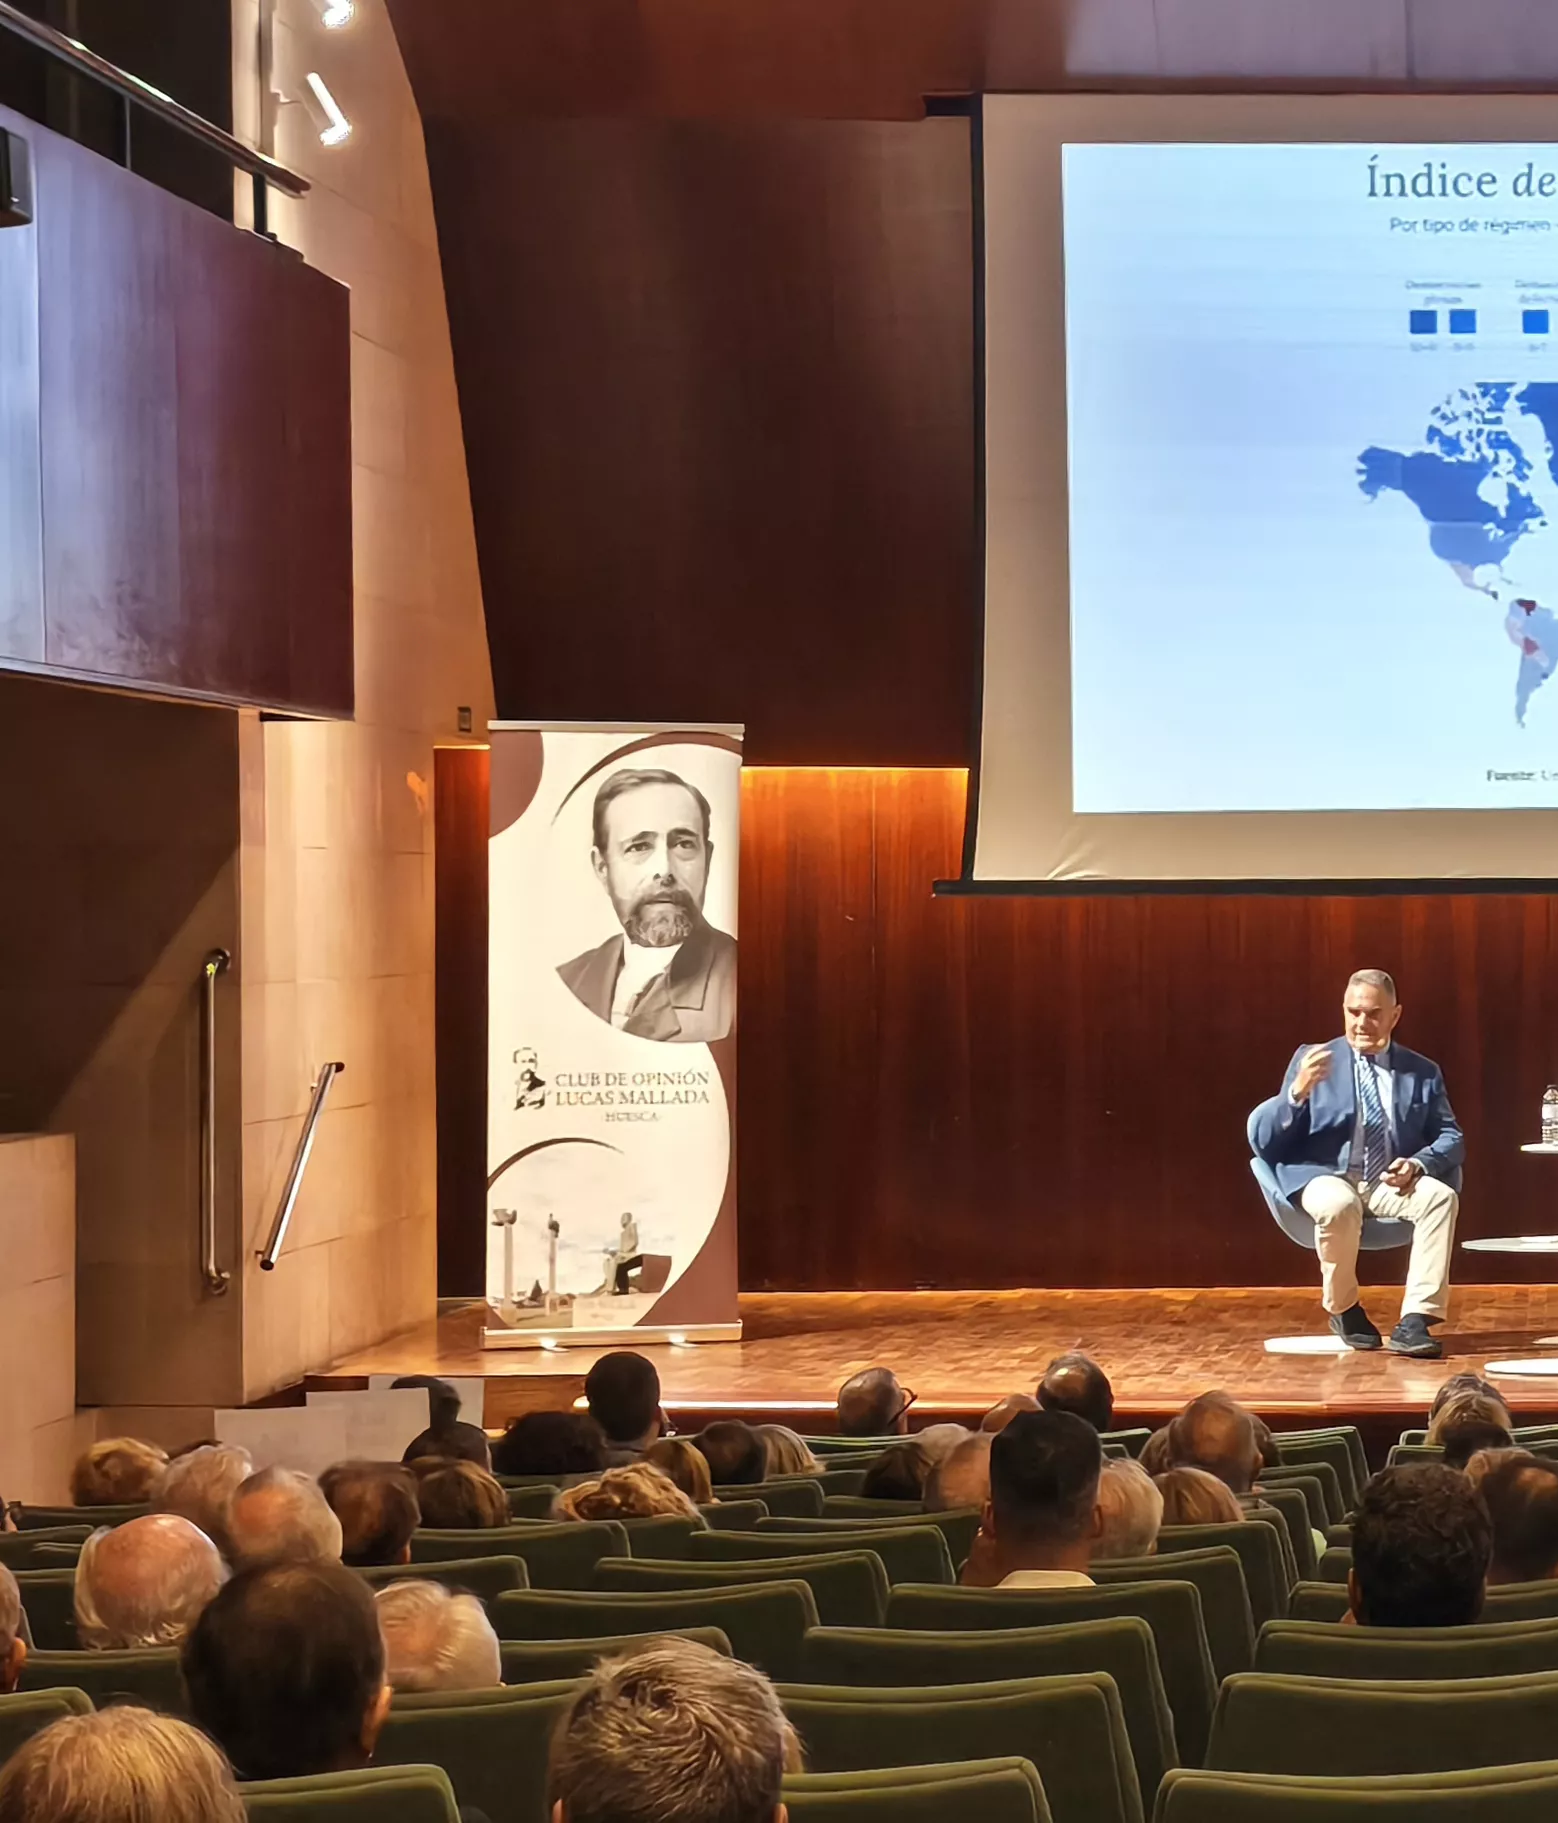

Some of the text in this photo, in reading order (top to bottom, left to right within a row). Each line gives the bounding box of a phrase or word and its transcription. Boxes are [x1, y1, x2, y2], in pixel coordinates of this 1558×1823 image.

[1367, 154, 1498, 197] Índice
[1512, 162, 1557, 197] de
[1390, 217, 1418, 231] Por
[1423, 218, 1454, 234] tipo
[1458, 217, 1480, 231] de
[555, 1068, 710, 1087] CLUB DE OPINIÓN
[555, 1089, 710, 1106] LUCAS MALLADA
